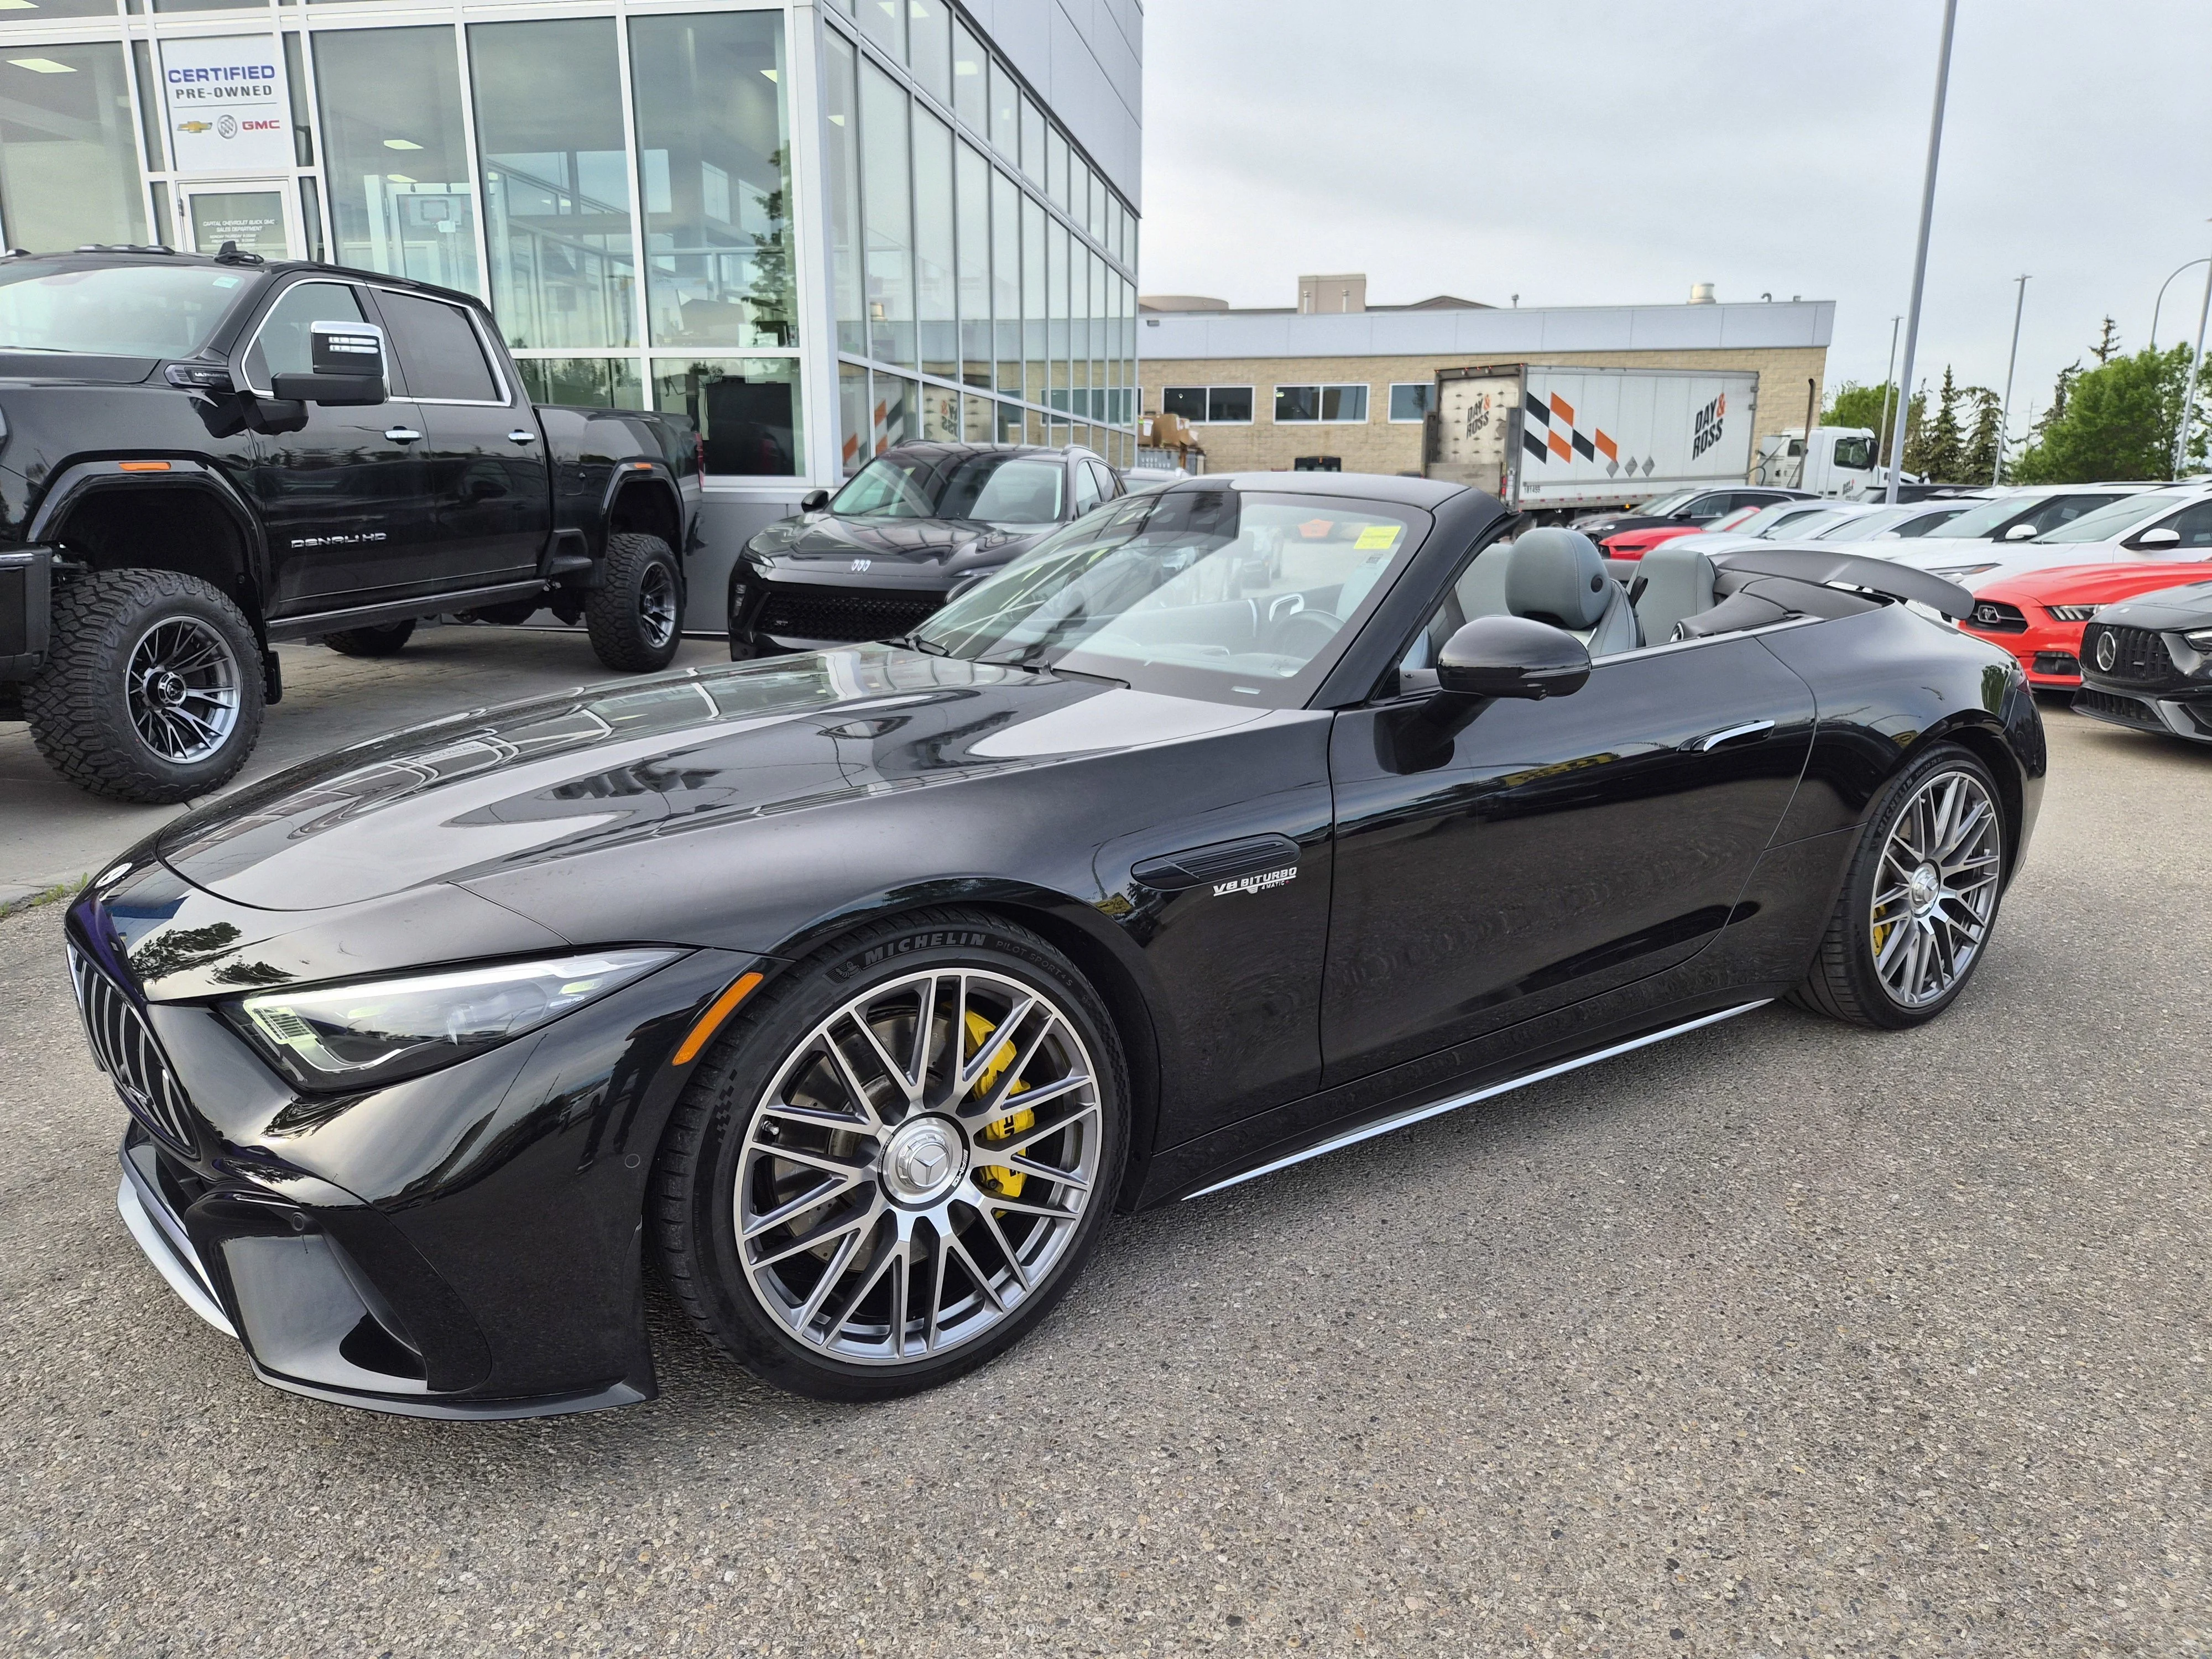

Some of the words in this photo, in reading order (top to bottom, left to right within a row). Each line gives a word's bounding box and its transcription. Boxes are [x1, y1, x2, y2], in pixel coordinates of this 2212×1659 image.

[168, 65, 275, 84] CERTIFIED
[175, 85, 273, 100] PRE-OWNED
[242, 120, 280, 131] GMC
[1692, 418, 1724, 461] ROSS
[291, 534, 359, 549] DENALI
[362, 533, 387, 541] HD
[1878, 778, 1913, 834] MICHELIN
[1213, 880, 1238, 894] V8
[1240, 867, 1297, 888] BITURBO
[865, 932, 986, 966] MICHELIN
[996, 941, 1027, 956] PILOT
[1029, 953, 1062, 975] SPORT
[951, 1160, 967, 1188] AMG
